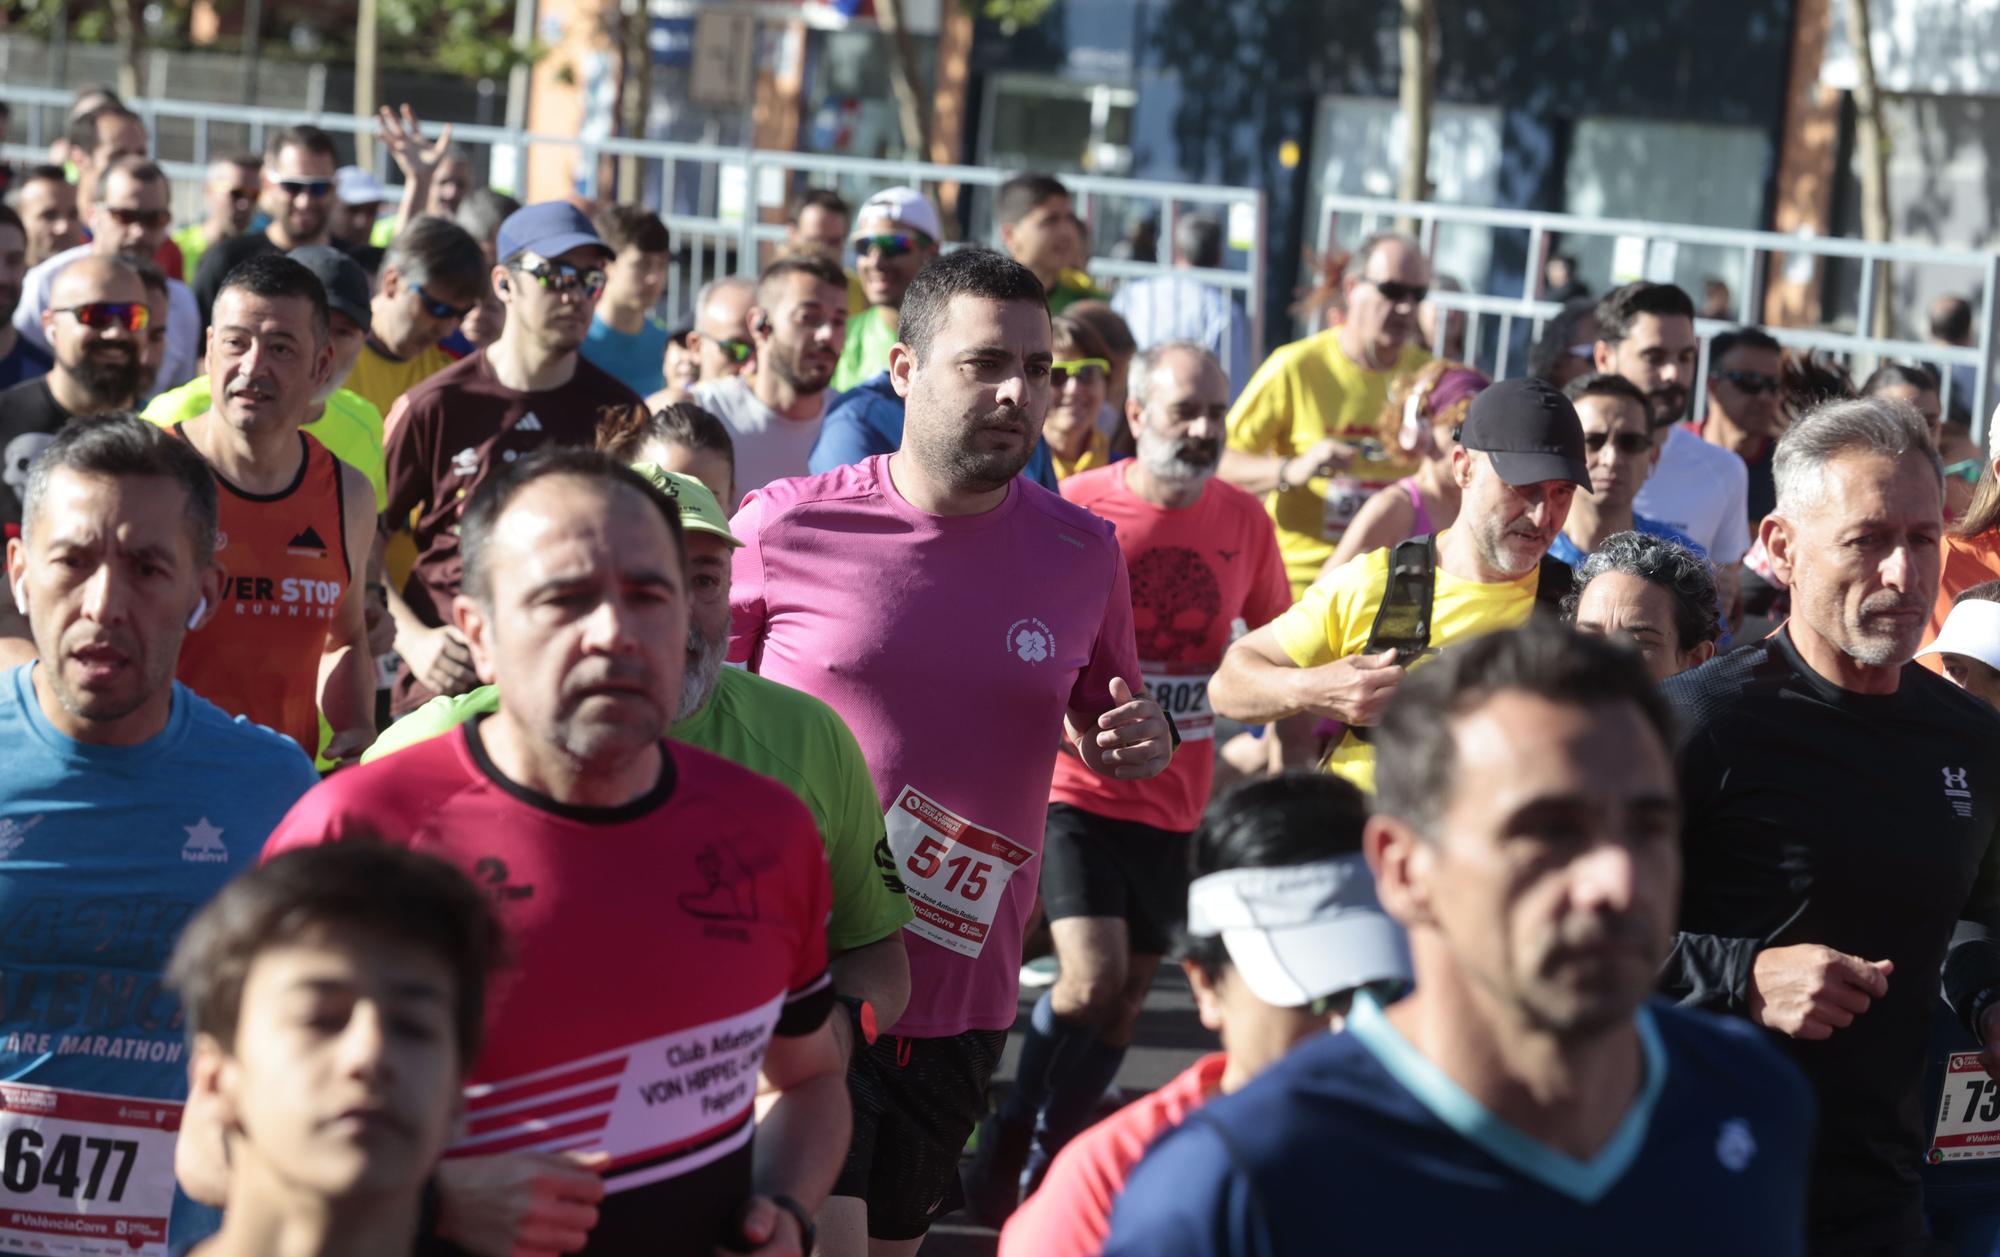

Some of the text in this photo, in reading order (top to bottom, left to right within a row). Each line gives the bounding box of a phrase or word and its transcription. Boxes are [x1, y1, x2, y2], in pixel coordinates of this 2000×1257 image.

[281, 577, 340, 605] STOP
[182, 849, 229, 863] luanvi
[906, 835, 993, 902] 515
[57, 1034, 184, 1063] MARATHON
[666, 1040, 706, 1069] Club
[639, 1075, 684, 1107] VON
[3, 1128, 139, 1203] 6477
[11, 1212, 108, 1233] #ValènciaCorre
